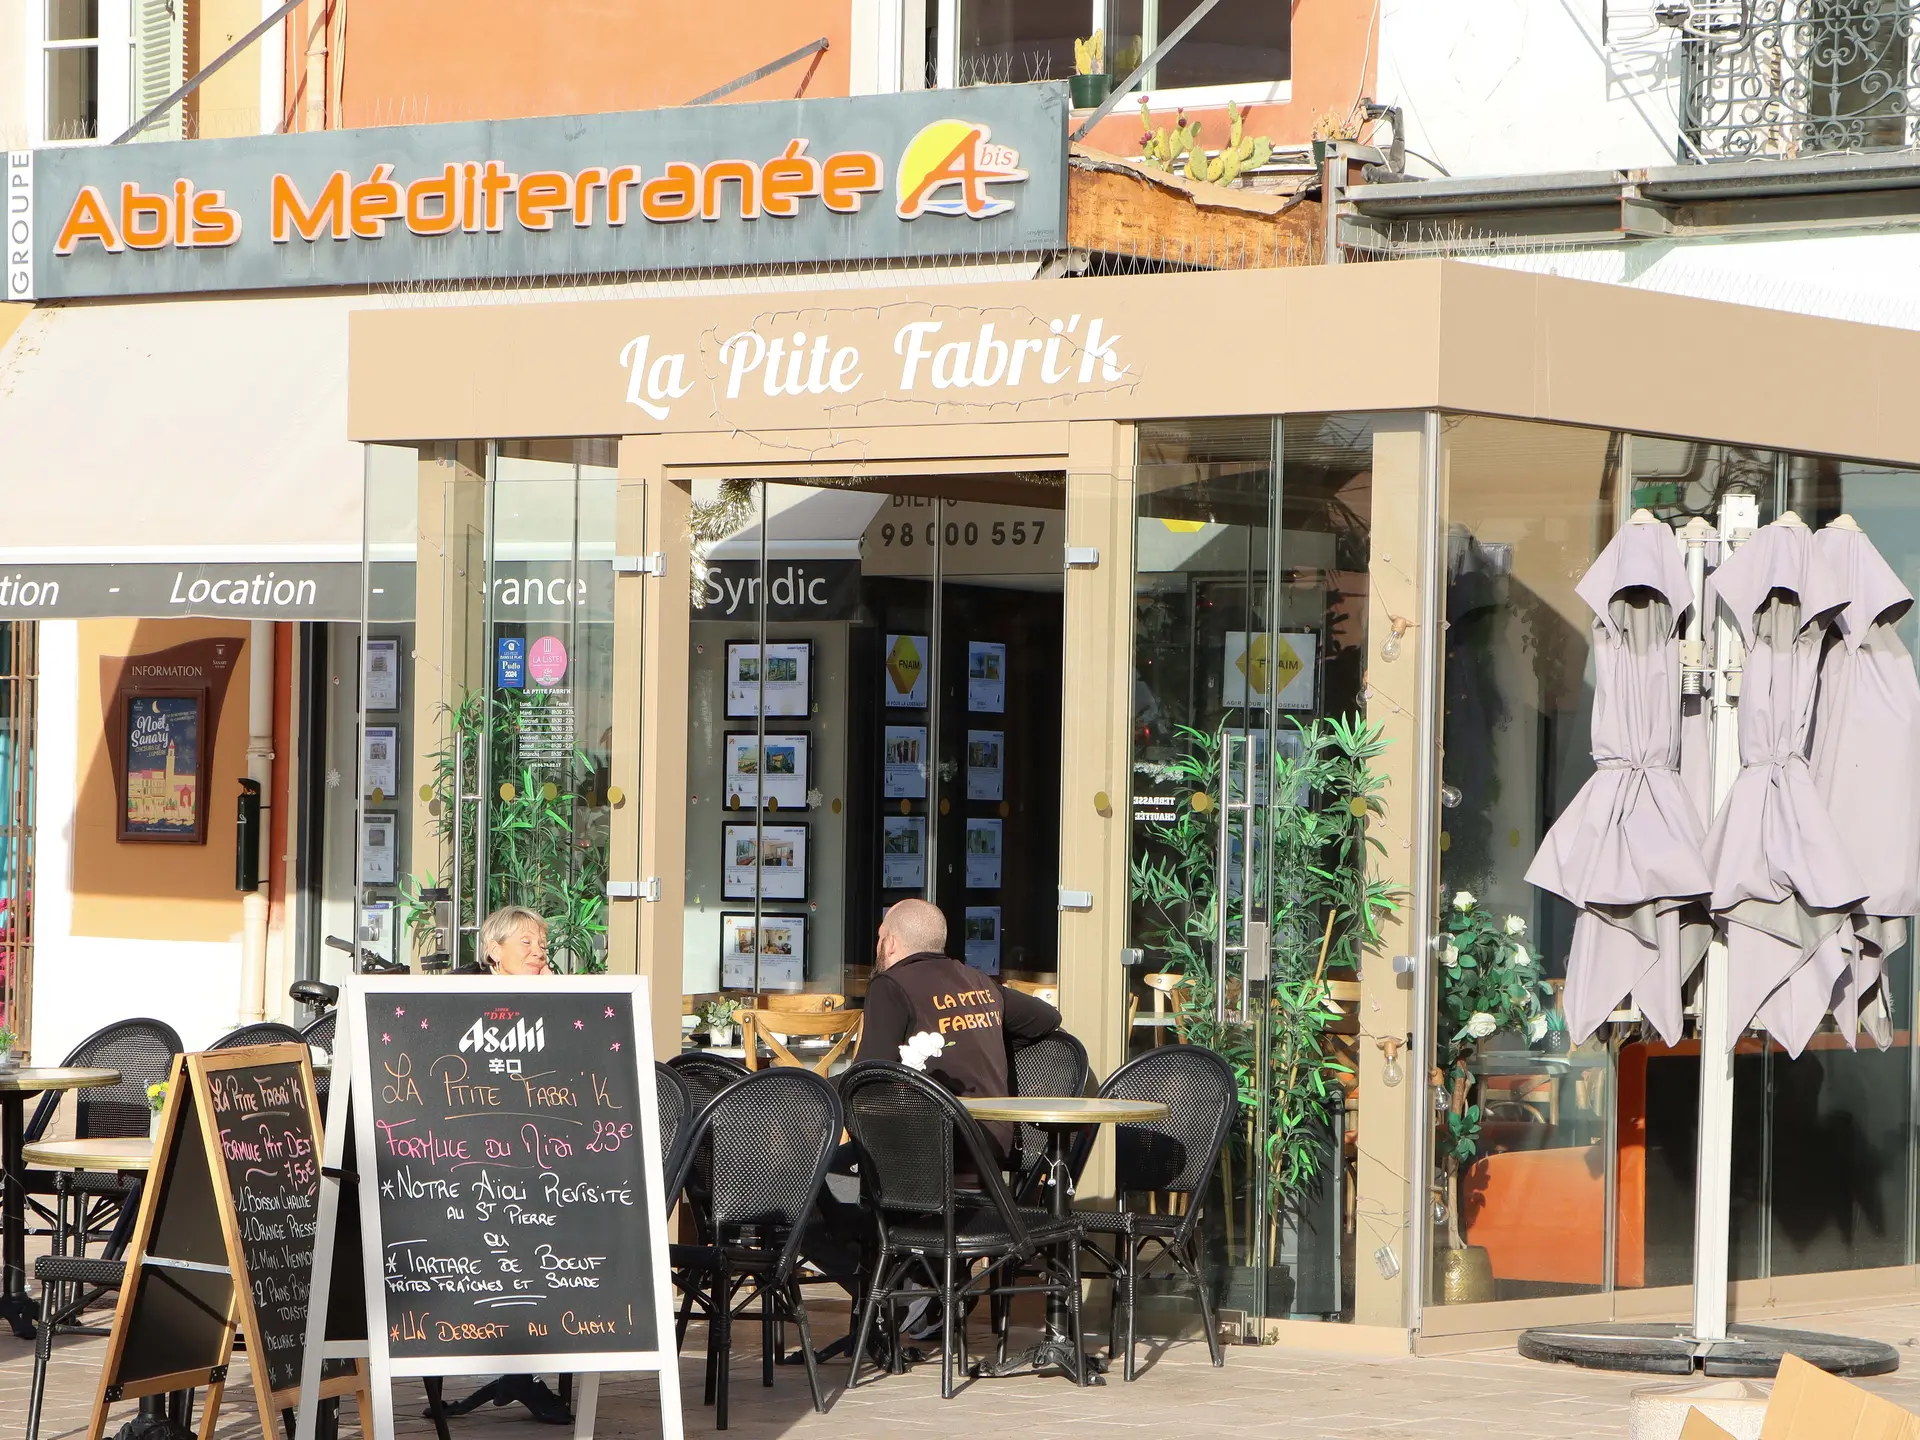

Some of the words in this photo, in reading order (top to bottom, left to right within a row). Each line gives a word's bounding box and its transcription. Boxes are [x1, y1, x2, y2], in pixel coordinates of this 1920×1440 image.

[53, 177, 242, 255] Abis
[271, 136, 884, 243] Méditerranée
[12, 153, 30, 295] GROUPE
[619, 334, 695, 420] La
[719, 330, 863, 399] Ptite
[893, 313, 1132, 390] Fabri'k
[881, 523, 914, 547] 98
[991, 521, 1046, 545] 557
[169, 571, 317, 605] Location
[706, 566, 828, 615] Syndic
[131, 665, 202, 677] INFORMATION
[502, 661, 520, 670] Pudlo
[899, 660, 920, 669] FNAIM
[1259, 660, 1299, 670] FAIM
[136, 714, 166, 733] Noël
[131, 729, 169, 748] Sanary
[933, 994, 958, 1010] LA
[958, 989, 995, 1006] PTITE
[458, 1017, 546, 1053] Asahi
[488, 1057, 522, 1074] 辛口
[219, 1129, 262, 1162] FORMULE
[376, 1118, 471, 1166] FORMULE
[484, 1139, 511, 1159] DU
[586, 1120, 633, 1152] 23€
[397, 1165, 461, 1200] NOTRE
[244, 1185, 281, 1213] BOISSON
[279, 1184, 312, 1211] CHAUDE
[446, 1206, 465, 1220] AU
[503, 1204, 557, 1226] PIERRE
[251, 1216, 287, 1242] ORANGE
[483, 1232, 510, 1247] OU
[388, 1240, 482, 1276] TARTARE
[498, 1258, 523, 1272] DE
[384, 1274, 431, 1294] FRITES
[513, 1279, 534, 1290] ET
[545, 1272, 600, 1289] SALADE
[401, 1310, 430, 1342] UN
[435, 1319, 510, 1342] DESSERT
[528, 1322, 548, 1336] AU
[561, 1311, 616, 1335] CHOIX
